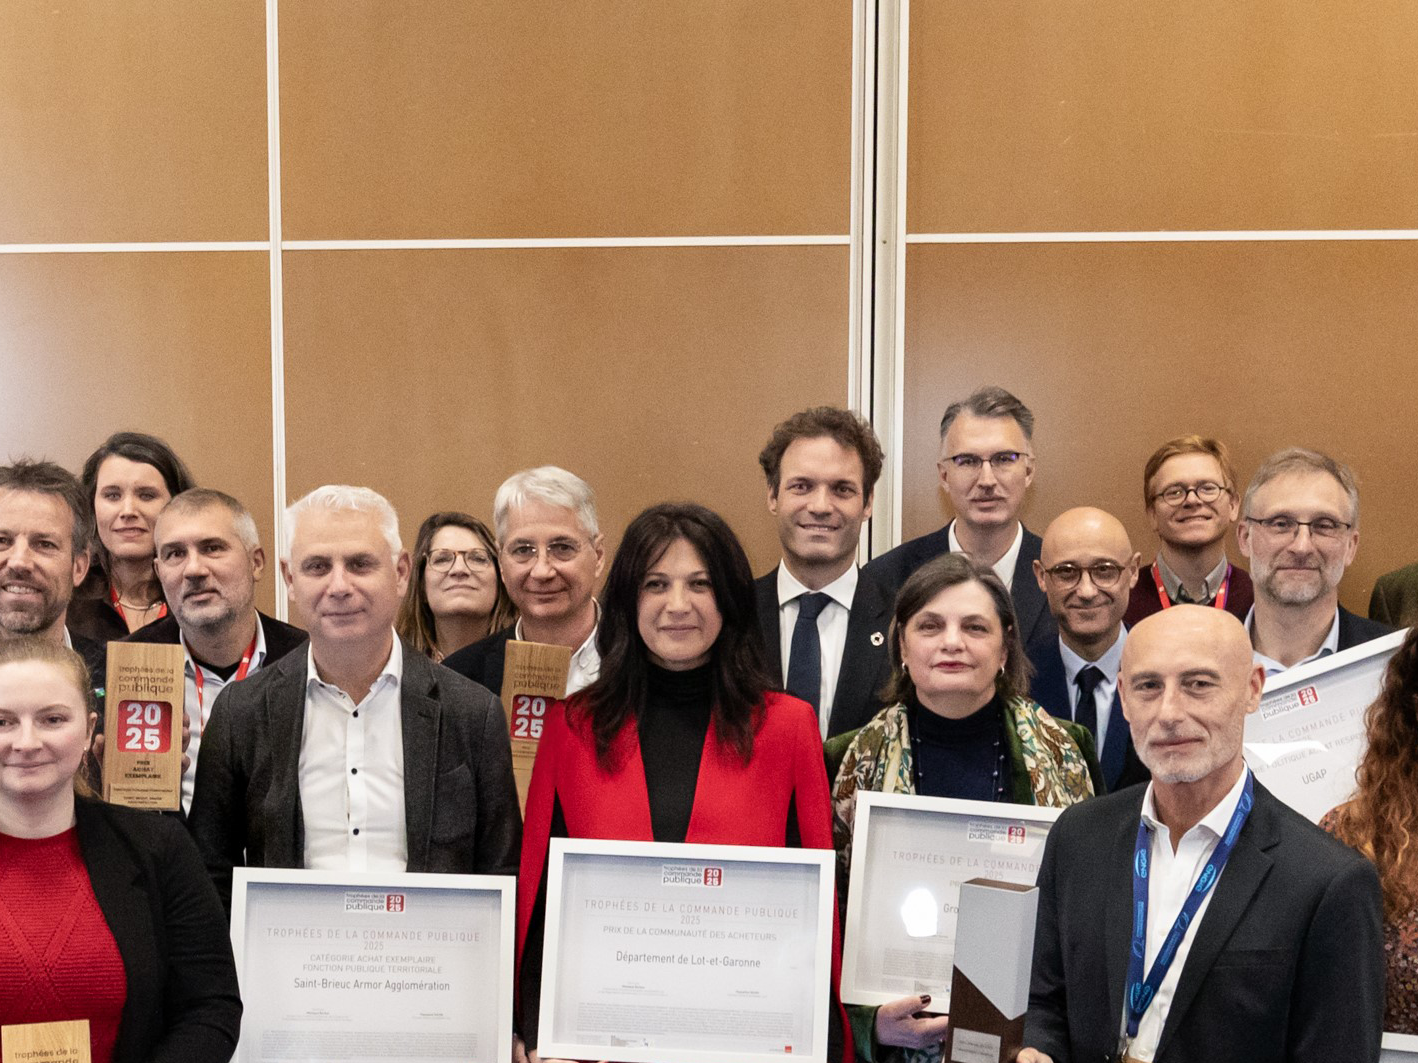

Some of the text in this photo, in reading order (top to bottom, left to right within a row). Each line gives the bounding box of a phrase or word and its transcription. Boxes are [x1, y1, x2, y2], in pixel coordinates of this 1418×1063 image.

[118, 682, 173, 696] publique
[517, 696, 546, 716] 20
[126, 703, 161, 726] 20
[514, 718, 543, 738] 25
[1288, 714, 1346, 738] COMMANDE
[125, 728, 160, 750] 25
[1267, 751, 1307, 769] OLITIQUE
[1302, 768, 1327, 785] UGAP
[892, 851, 945, 865] TROPHÉES
[949, 856, 962, 866] DE
[967, 858, 979, 867] LA
[663, 876, 702, 884] publique
[346, 903, 385, 912] publique
[584, 899, 799, 919] TROPHÉES DE LA COMMANDE PUBLIQUE
[680, 915, 701, 925] 2025
[267, 927, 480, 942] TROPHÉES DE LA COMMANDE PUBLIQUE
[603, 926, 622, 934] PRIX
[648, 928, 708, 938] COMMUNAUTÉ
[709, 931, 726, 939] DES
[727, 932, 777, 941] ACHETEURS
[363, 941, 384, 951] 2025
[310, 953, 436, 964] CATÉGORIE ACHAT EXEMPLAIRE
[616, 951, 761, 968] Département de Lot-et-Garonne
[303, 964, 443, 974] FONCTION PUBLIQUE TERRITORIALE
[294, 978, 450, 992] Saint-Brieuc Armor Agglomération
